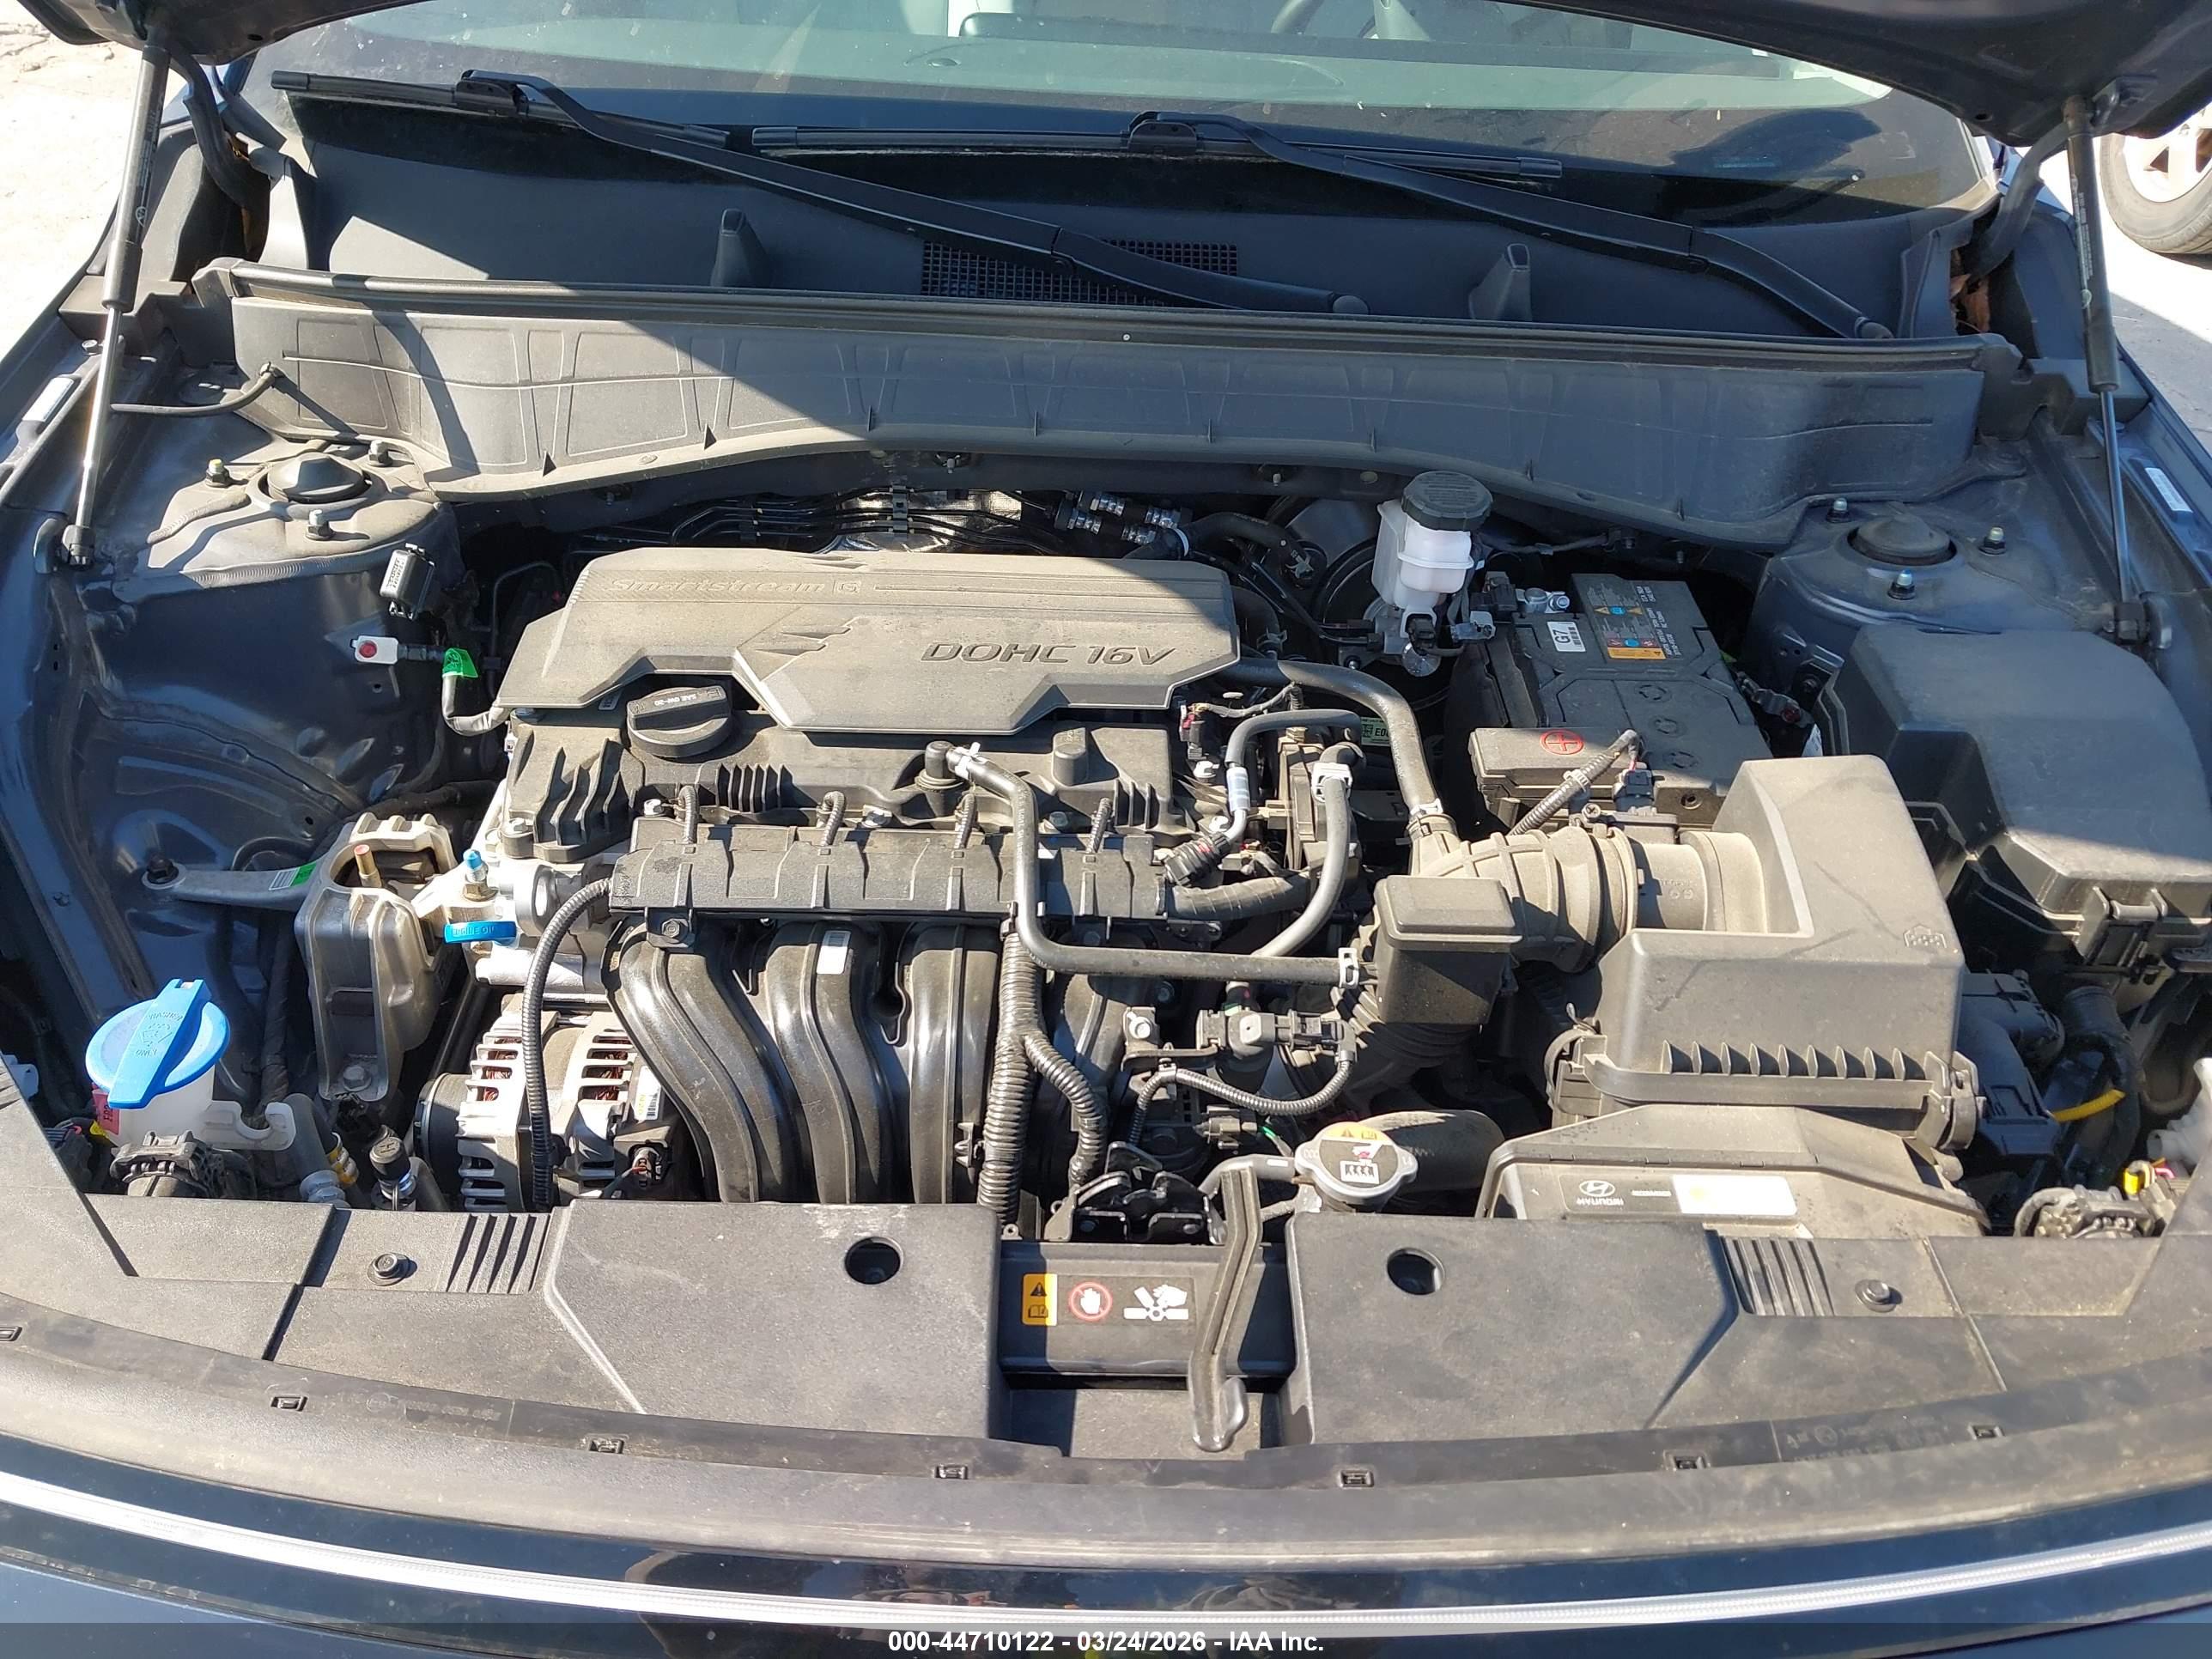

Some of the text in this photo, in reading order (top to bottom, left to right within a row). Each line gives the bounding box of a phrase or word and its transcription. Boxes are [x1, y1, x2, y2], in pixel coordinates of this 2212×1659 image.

[611, 578, 825, 592] Smartstream
[1553, 629, 1571, 644] G7
[921, 643, 1176, 665] DOHC 16V
[453, 926, 480, 937] ENGINE
[136, 1048, 158, 1057] ONLY
[1576, 1197, 1625, 1206] HYUNDAI
